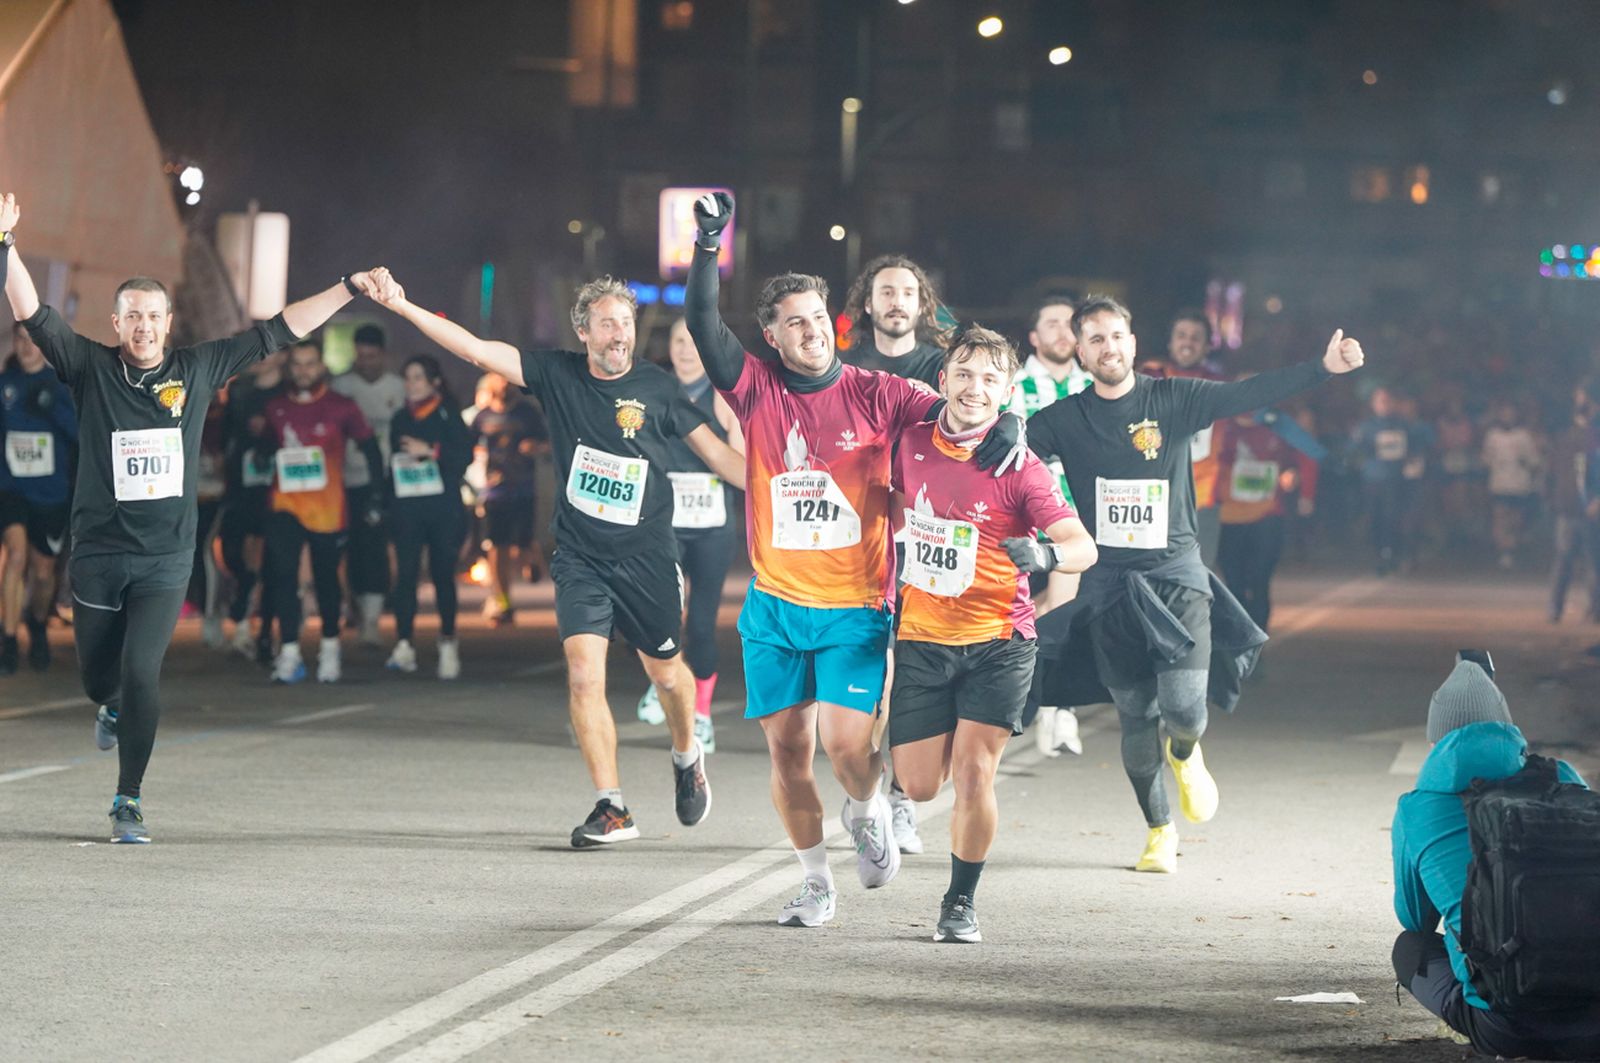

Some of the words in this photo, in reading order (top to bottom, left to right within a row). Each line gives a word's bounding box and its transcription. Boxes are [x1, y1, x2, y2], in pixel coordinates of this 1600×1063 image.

[170, 405, 182, 418] 14
[622, 428, 636, 439] 14
[127, 439, 150, 447] NOCHE
[121, 447, 136, 456] SAN
[1143, 448, 1158, 460] 14
[127, 456, 170, 476] 6707
[581, 462, 595, 472] SAN
[591, 457, 611, 468] NOCHE
[579, 472, 634, 502] 12063
[791, 480, 815, 488] NOCHE
[782, 490, 798, 498] SAN
[792, 500, 840, 522] 1247
[1108, 504, 1153, 524] 6704
[910, 527, 921, 538] SAN
[916, 522, 935, 534] NOCHE
[936, 526, 946, 535] DE
[915, 541, 958, 570] 1248
